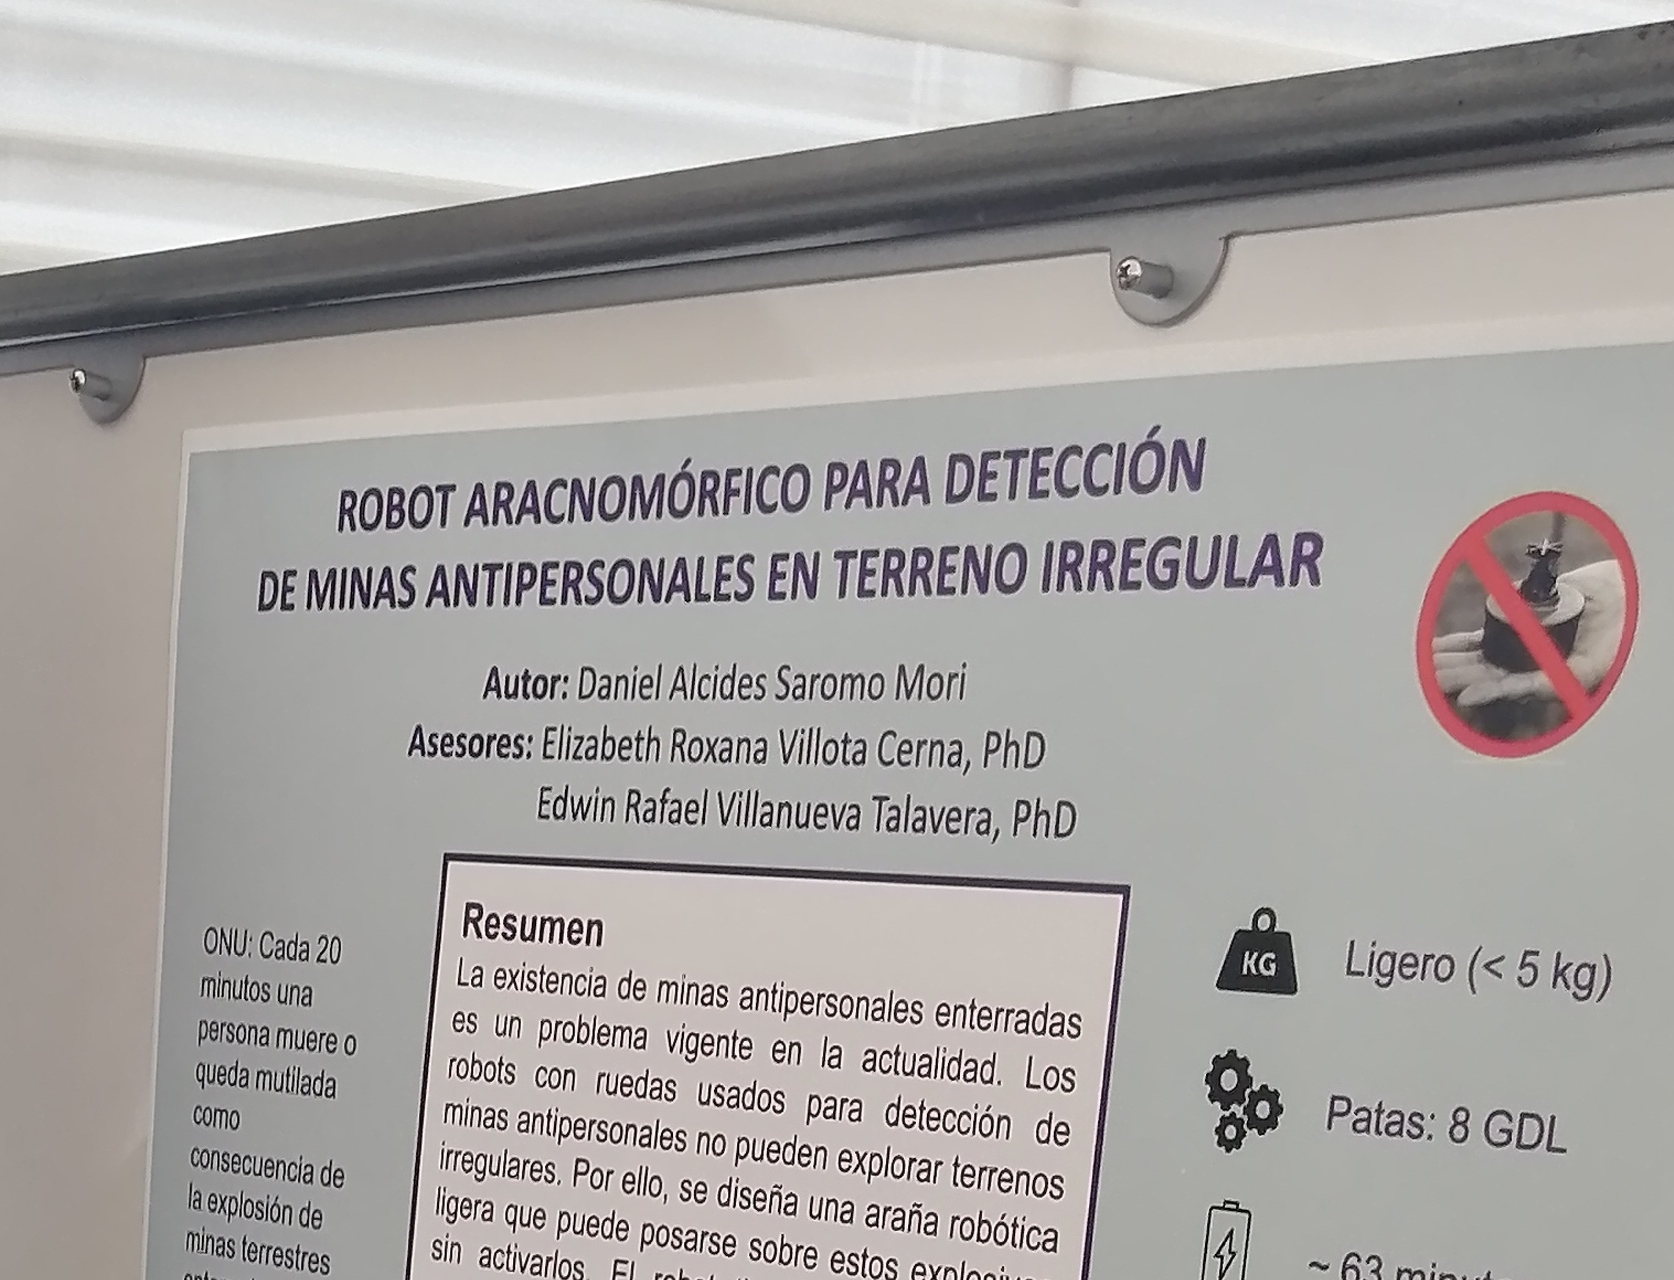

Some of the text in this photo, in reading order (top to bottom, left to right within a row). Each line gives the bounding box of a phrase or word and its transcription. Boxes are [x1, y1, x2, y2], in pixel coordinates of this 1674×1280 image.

[338, 424, 1206, 533] ROBOT ARACNOMÓRFICO PARA DETECCIÓN
[258, 532, 1323, 612] DE MINAS ANTIPERSONALES EN TERRENO IRREGULAR
[483, 662, 967, 701] Autor: Daniel Alcides Saromo Mori
[408, 724, 1045, 776] Asesores: Elizabeth Roxana Villota Cerna, PhD
[538, 784, 1076, 844] Edwin Rafael Villanueva Talavera, PhD
[204, 927, 341, 965] ONU: Cada 20
[463, 902, 603, 947] Resumen
[1241, 950, 1277, 977] KG
[1346, 940, 1611, 1003] Ligero (< 5 kg)
[200, 971, 312, 1007] minutos una
[457, 957, 1082, 1039] La existencia de minas antipersonales enterradas
[198, 1020, 356, 1056] persona muere o
[452, 1011, 1076, 1093] es un problema vigente en la actualidad. Los
[196, 1059, 336, 1099] queda mutilada
[448, 1051, 1070, 1146] robots con ruedas usados para detección de
[193, 1105, 240, 1131] como
[1327, 1095, 1567, 1153] Patas: 8 GDL
[191, 1147, 344, 1189] consecuencia de
[188, 1181, 322, 1230] la explosión de
[186, 1226, 330, 1275] minas terrestres
[1309, 1261, 1330, 1271] ~
